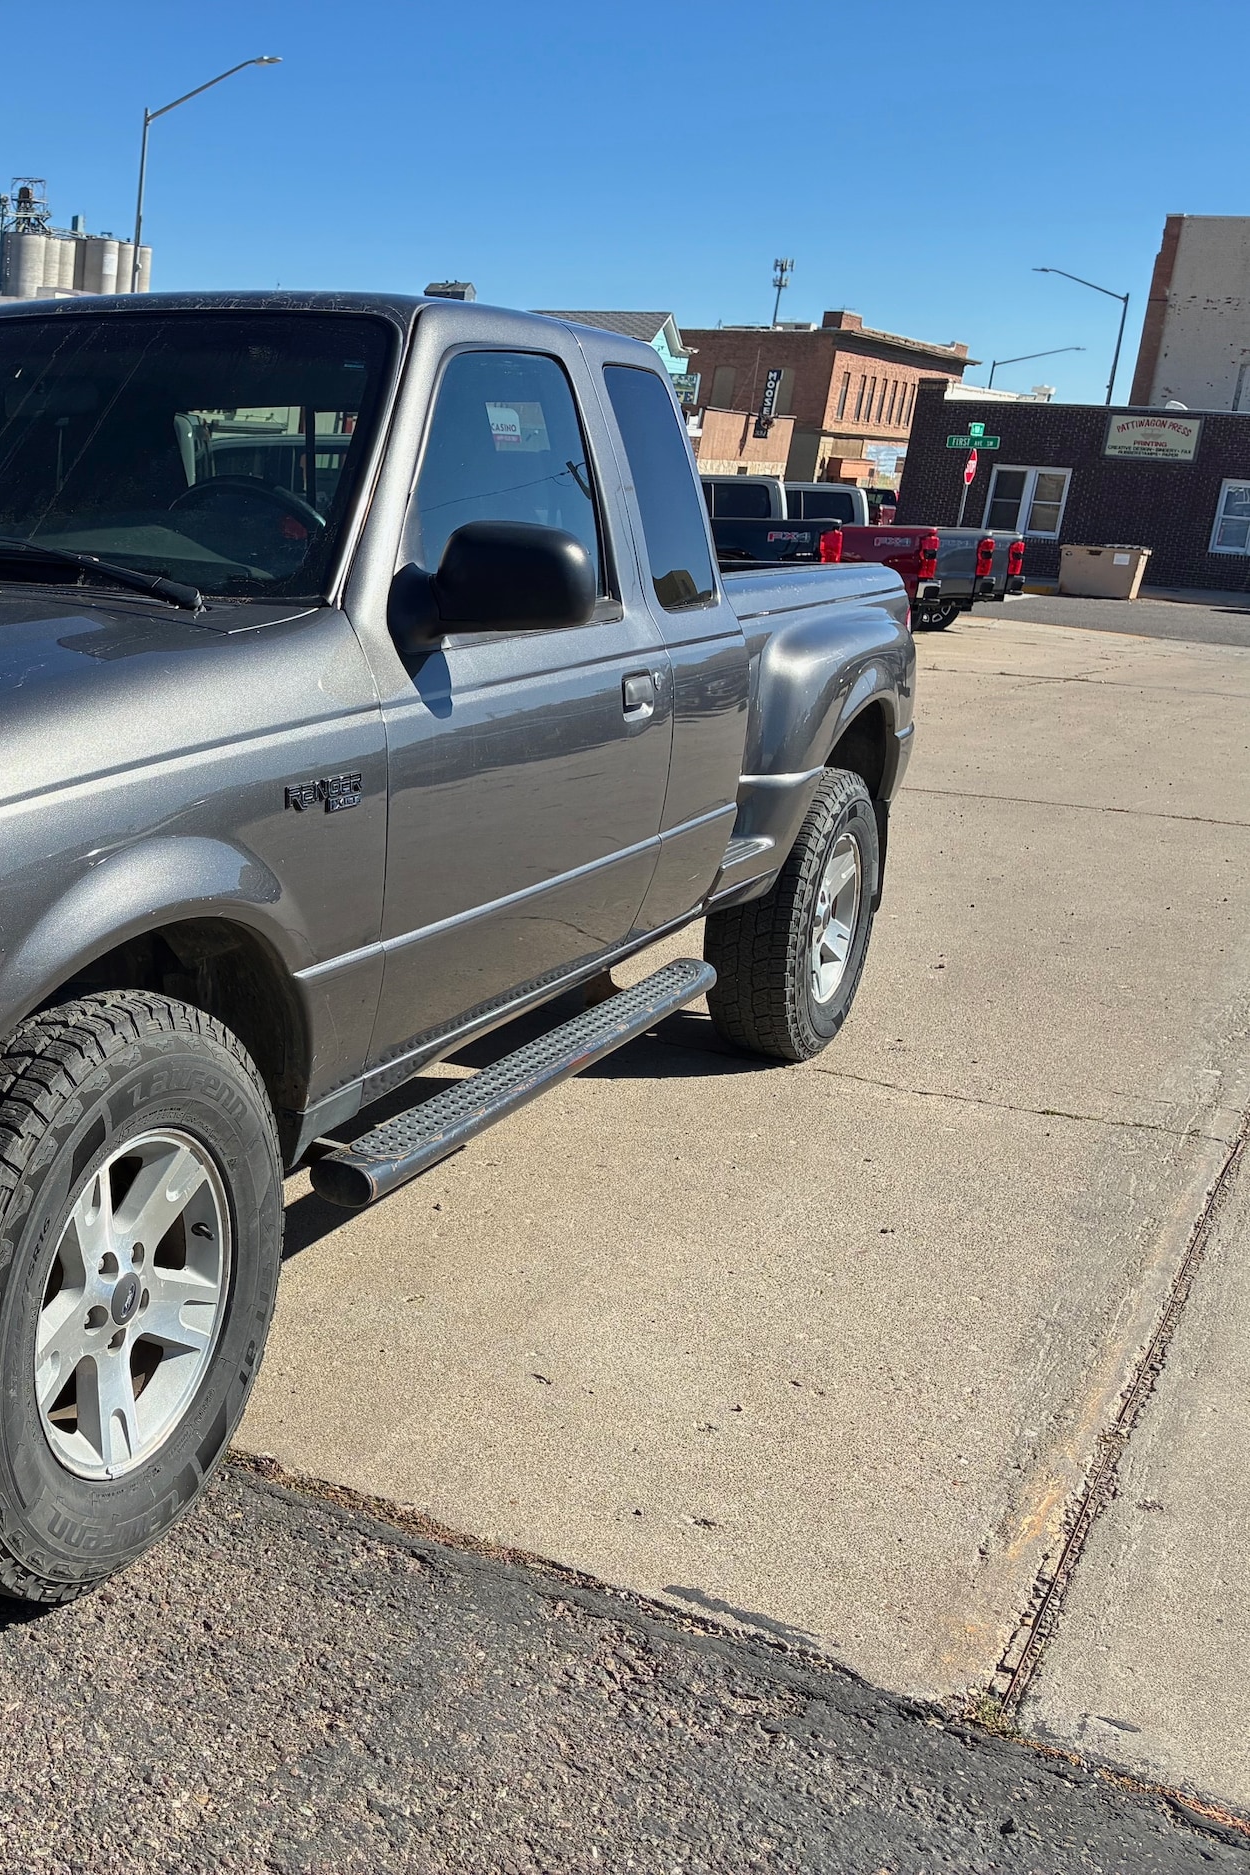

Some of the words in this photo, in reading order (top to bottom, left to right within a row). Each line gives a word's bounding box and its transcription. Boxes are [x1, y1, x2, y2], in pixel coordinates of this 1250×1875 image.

[762, 371, 778, 416] MOOSE
[491, 422, 517, 432] CASINO
[1116, 418, 1167, 434] PATTIWAGON
[1168, 421, 1192, 437] PRESS
[952, 438, 970, 446] FIRST
[1133, 440, 1167, 448] PRINTING
[767, 531, 811, 543] FX4
